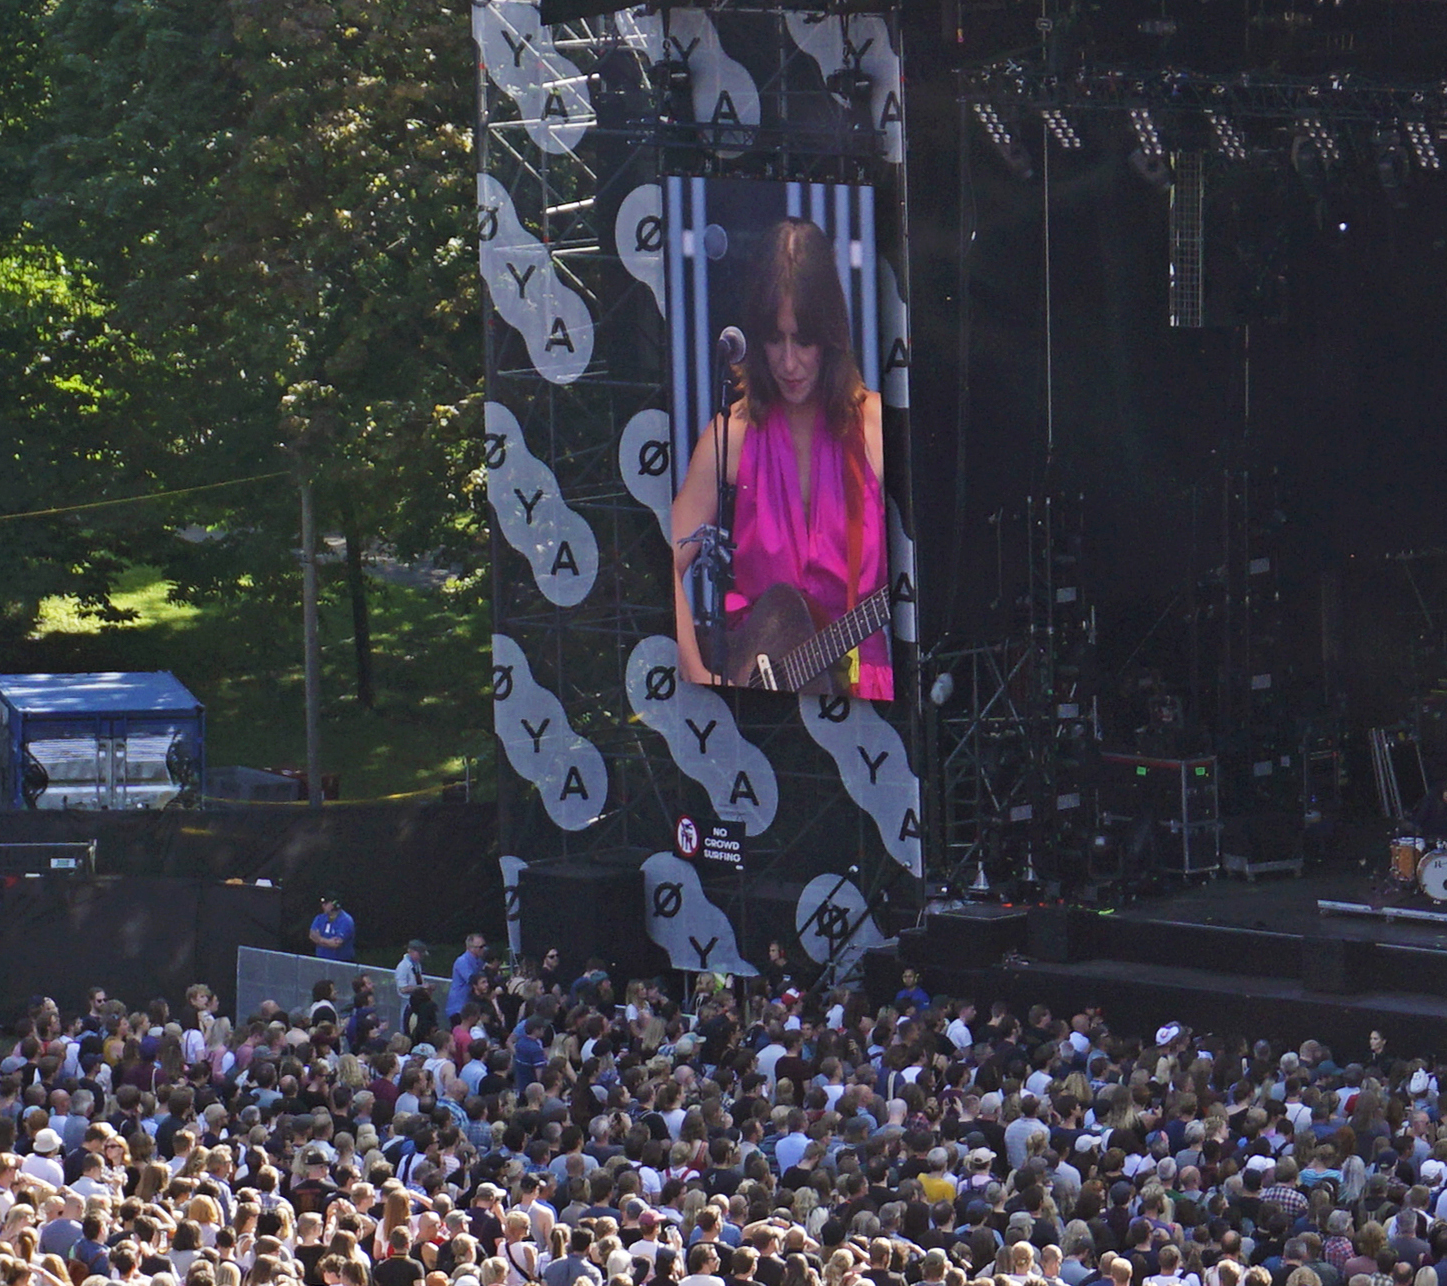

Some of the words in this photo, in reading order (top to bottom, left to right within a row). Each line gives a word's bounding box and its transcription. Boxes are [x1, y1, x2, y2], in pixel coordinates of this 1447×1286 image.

[645, 664, 760, 807] ØYA
[713, 827, 728, 838] NO
[704, 837, 740, 851] CROWD
[703, 849, 742, 863] SURFING
